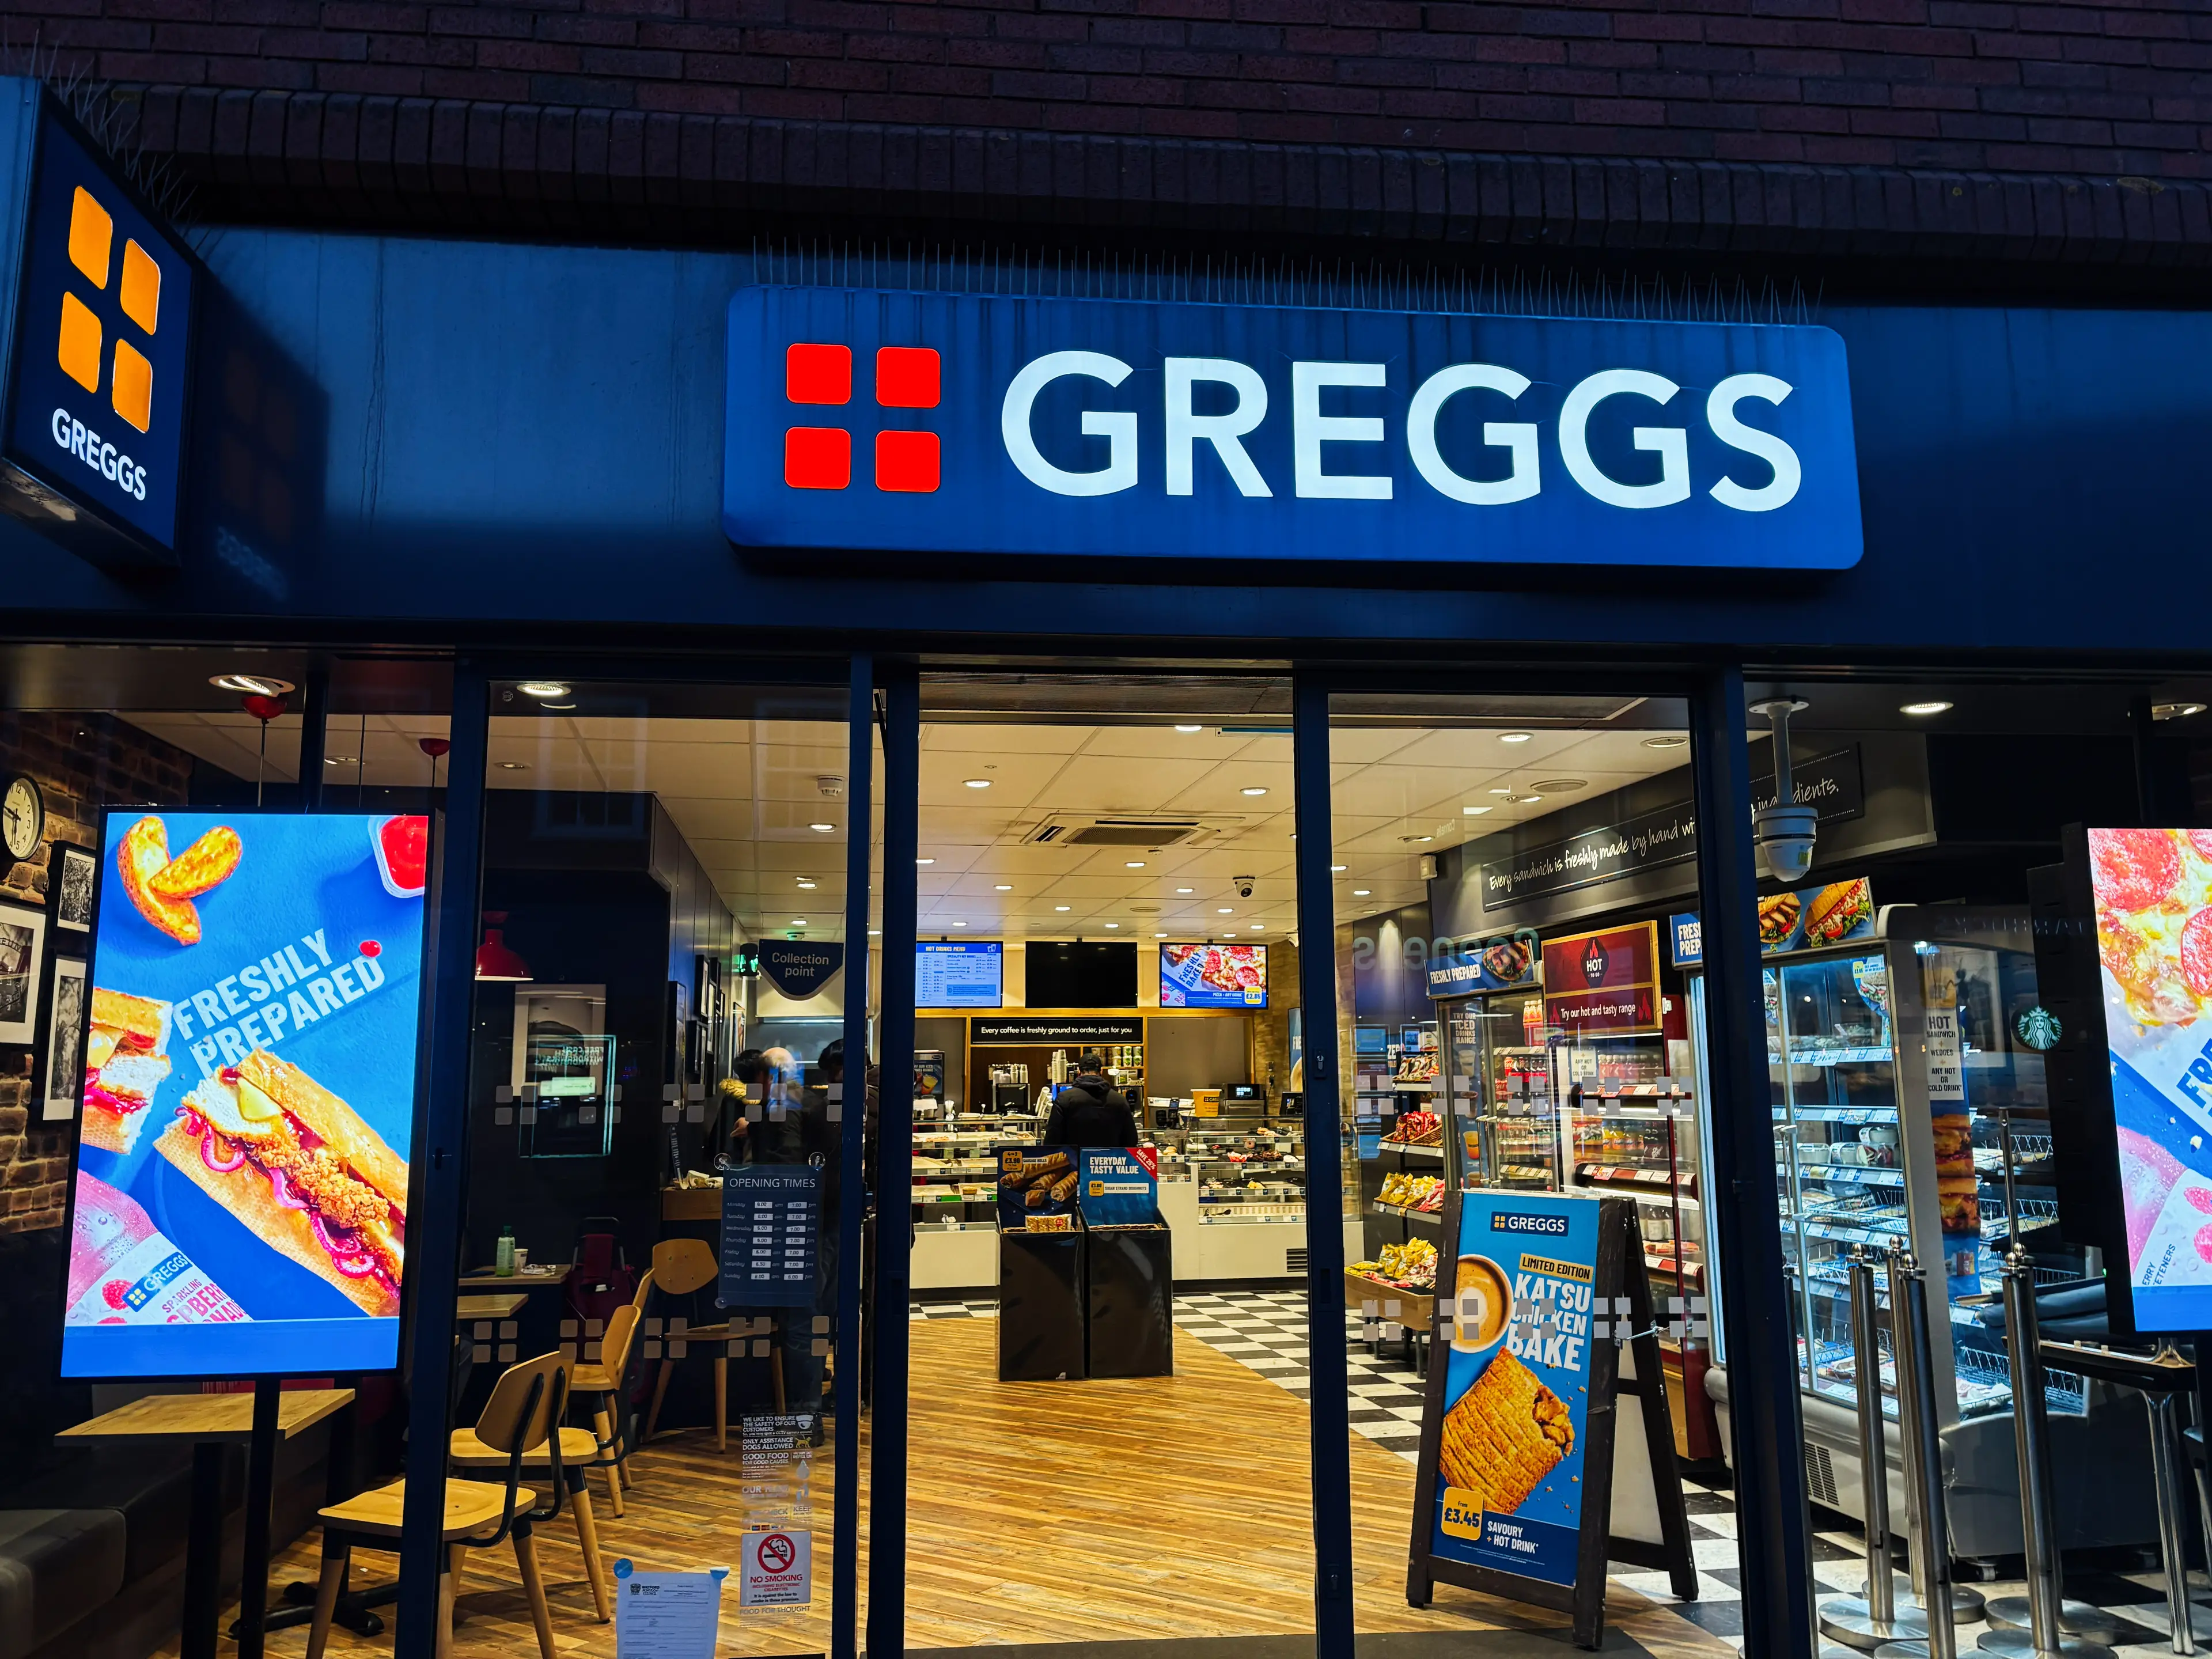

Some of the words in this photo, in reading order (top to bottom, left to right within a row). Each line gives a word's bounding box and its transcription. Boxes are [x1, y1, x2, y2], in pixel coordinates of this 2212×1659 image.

[1001, 349, 1801, 513] GREGGS
[52, 408, 146, 501] GREGGS
[1489, 875, 1512, 892] Every
[1514, 859, 1554, 882] sandwich
[1554, 857, 1563, 872] is
[1565, 845, 1598, 870] freshly
[1600, 836, 1629, 860] made
[1632, 836, 1647, 857] by
[1649, 823, 1679, 846] hand
[1679, 938, 1702, 956] PREP
[772, 952, 829, 965] Collection
[1179, 952, 1202, 983] FRESHLY
[1586, 959, 1602, 972] HOT
[785, 965, 815, 978] point
[1185, 963, 1205, 988] BAKED
[1430, 969, 1451, 984] FRESHLY
[1451, 964, 1481, 982] PREPARED
[173, 928, 332, 1040] FRESHLY
[189, 956, 385, 1080] PREPARED
[1561, 1009, 1569, 1021] Try
[1570, 1010, 1580, 1018] our
[1581, 1006, 1590, 1017] hot
[1592, 1004, 1602, 1016] and
[1603, 1006, 1618, 1017] tasty
[1619, 1004, 1636, 1015] range
[981, 1027, 998, 1035] Every
[1027, 1027, 1047, 1035] freshly
[1048, 1027, 1070, 1035] ground
[1098, 1027, 1109, 1035] just
[1455, 1020, 1475, 1030] ICED
[1928, 1016, 1950, 1029] HOT
[1090, 1157, 1126, 1165] EVERYDAY
[1136, 1149, 1147, 1160] SAVE
[1145, 1158, 1156, 1170] 25%
[1090, 1166, 1113, 1174] TASTY
[1115, 1165, 1139, 1174] VALUE
[729, 1178, 780, 1187] OPENING
[783, 1179, 816, 1188] TIMES
[1508, 1216, 1565, 1232] GREGGS
[144, 1253, 188, 1292] GREGGS
[1522, 1256, 1555, 1272] LIMITED
[1557, 1264, 1590, 1279] EDITION
[162, 1278, 202, 1313] SPARKLING
[1514, 1272, 1592, 1312] KATSU
[1506, 1323, 1585, 1372] BAKE
[1444, 1508, 1480, 1528] £3.45
[1487, 1521, 1524, 1536] SAVOURY
[1494, 1534, 1510, 1548] HOT
[765, 1574, 803, 1582] SMOKING
